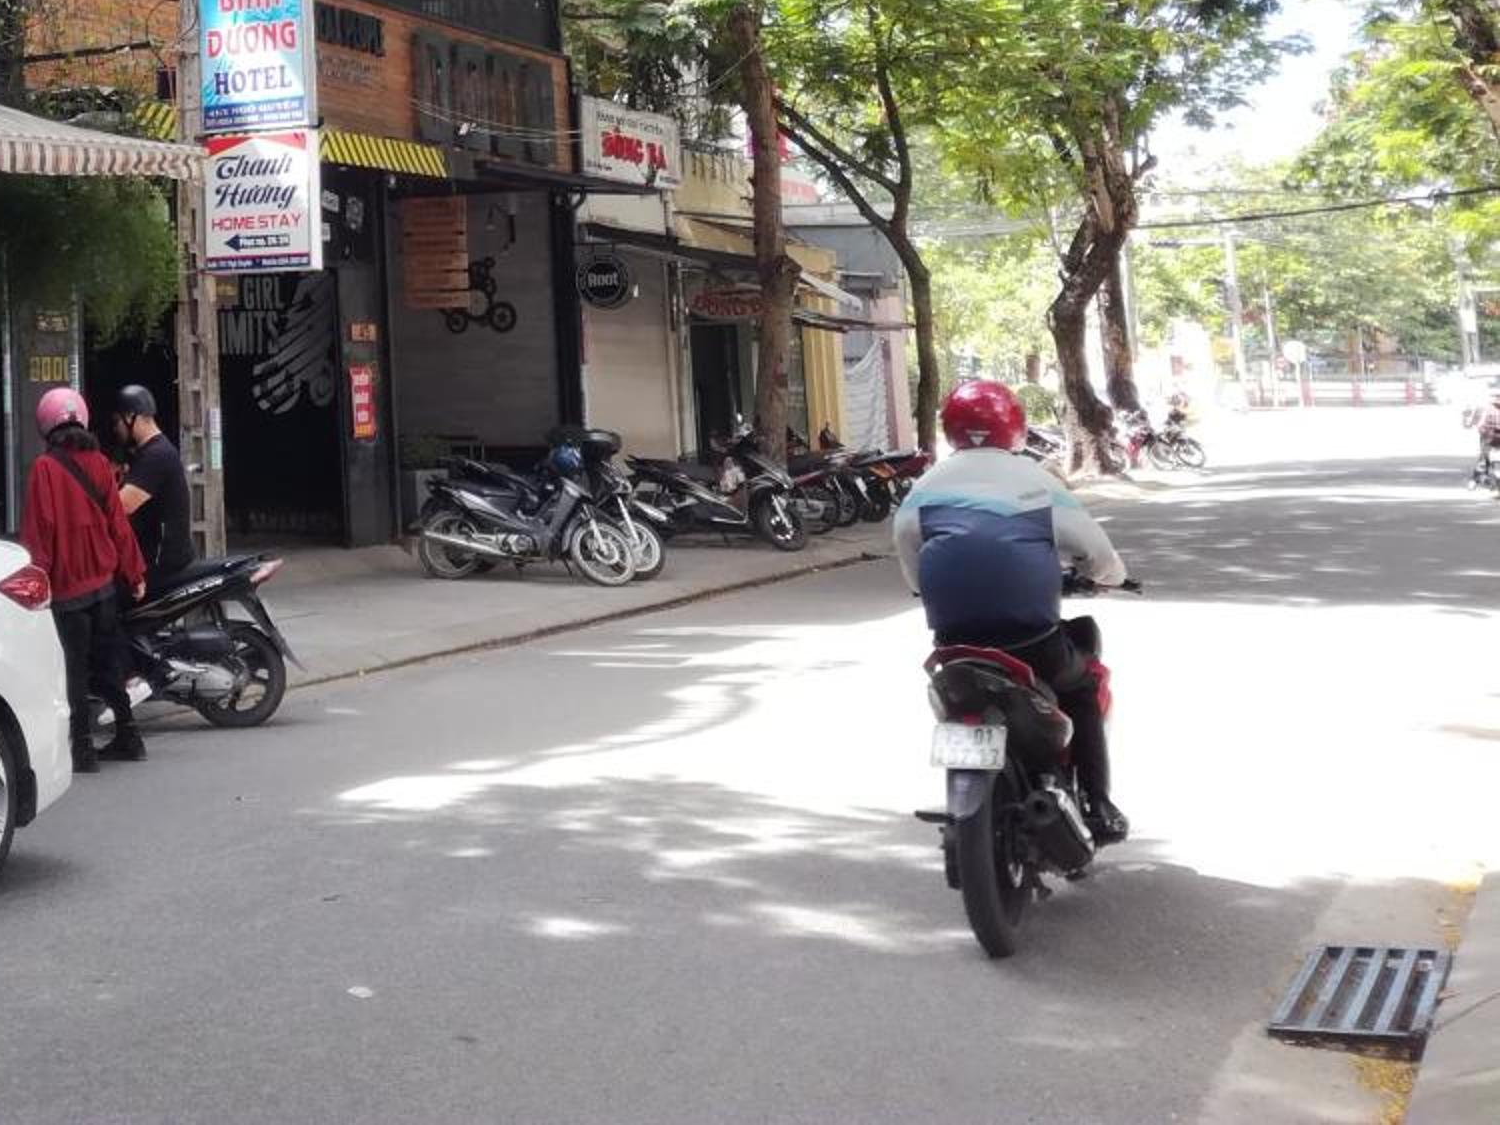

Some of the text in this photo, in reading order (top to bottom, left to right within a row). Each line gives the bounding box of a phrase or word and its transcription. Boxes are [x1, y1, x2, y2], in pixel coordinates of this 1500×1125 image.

[214, 65, 293, 95] HOTEL
[215, 154, 293, 180] Thanh
[220, 309, 279, 355] IMITS
